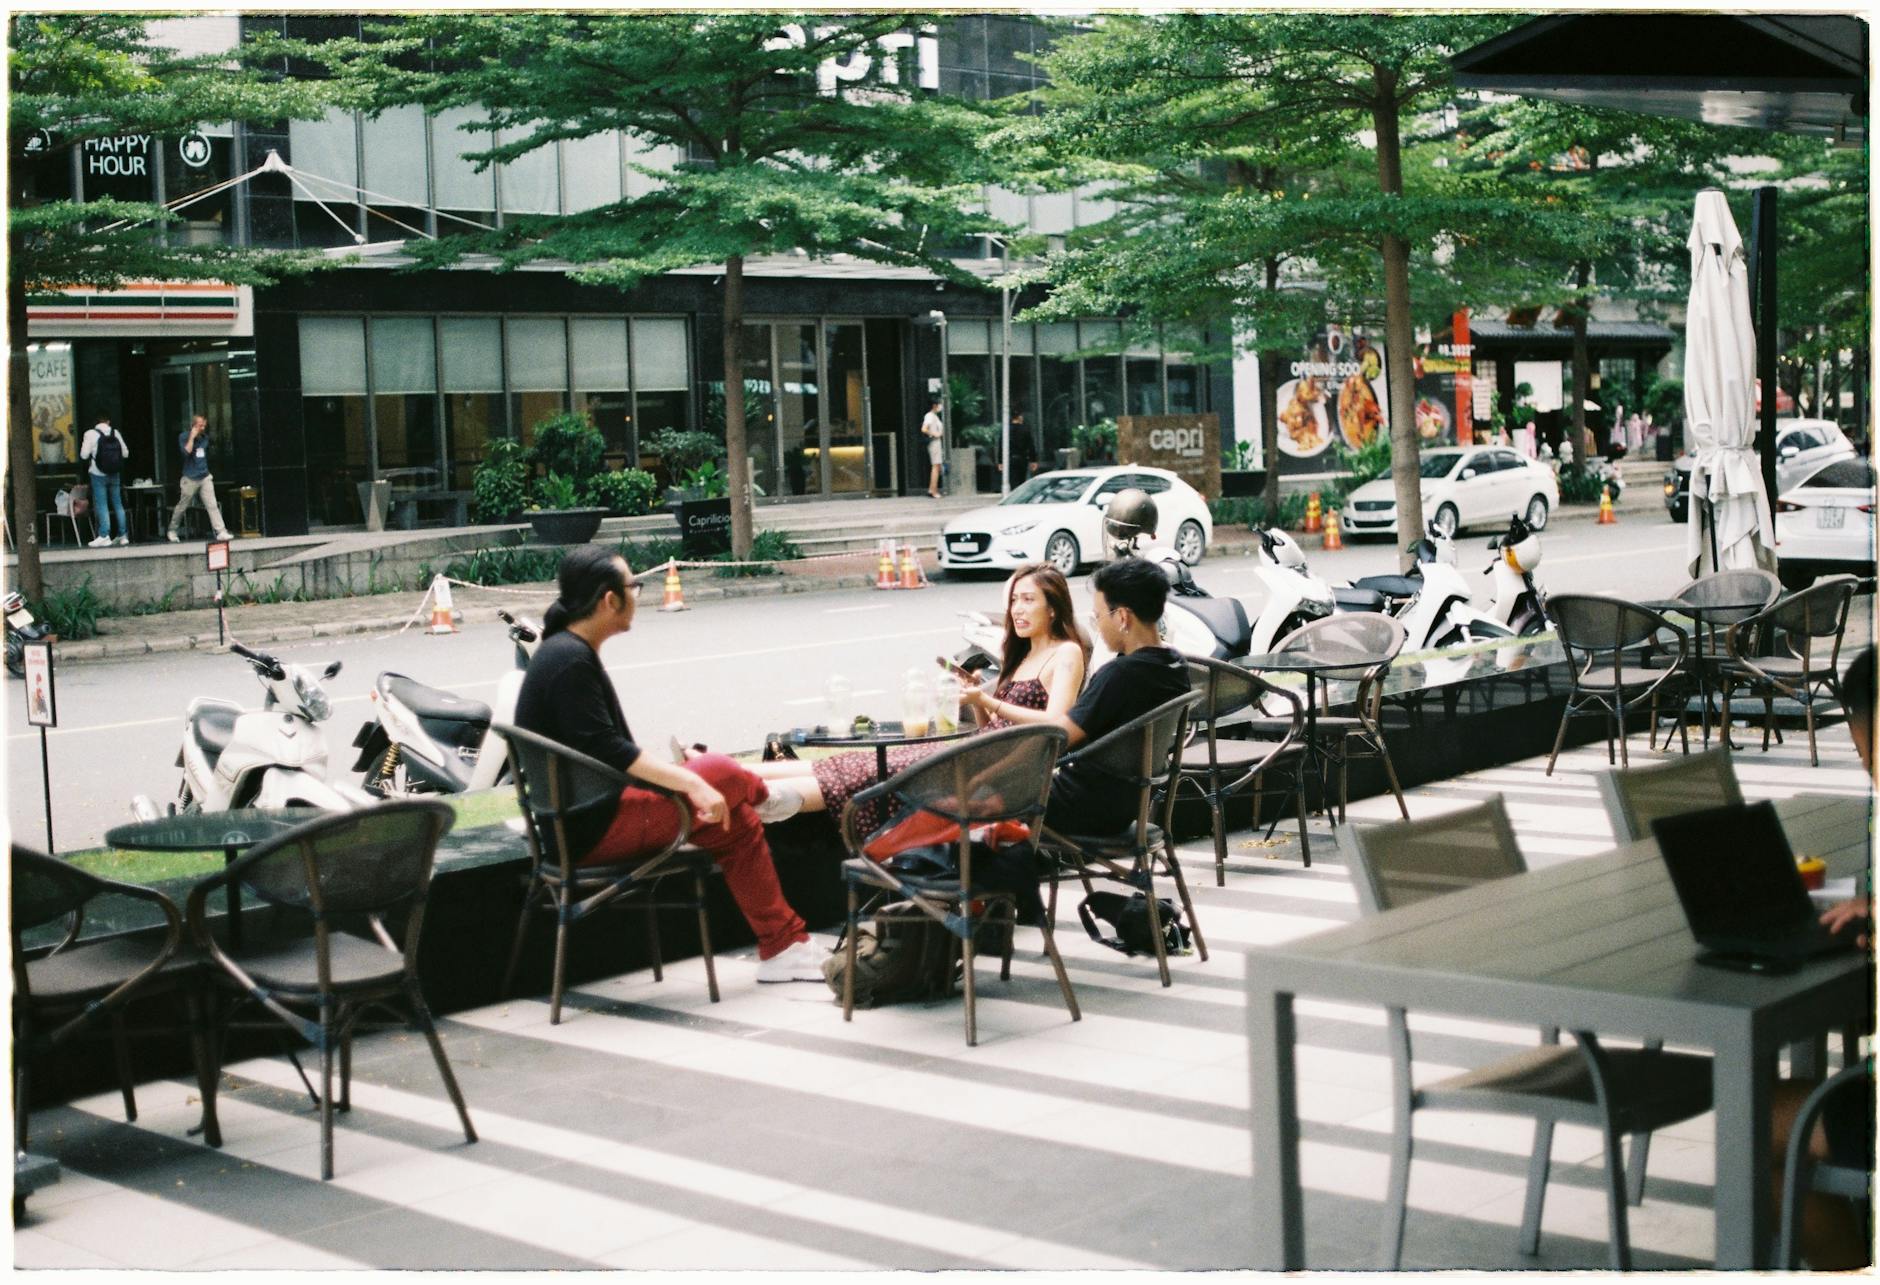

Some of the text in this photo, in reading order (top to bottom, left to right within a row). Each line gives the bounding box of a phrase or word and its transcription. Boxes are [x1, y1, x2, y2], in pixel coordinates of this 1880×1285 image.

[84, 134, 151, 154] HAPPY
[89, 155, 146, 176] HOUR
[1290, 361, 1362, 377] OPENING SOO
[1149, 421, 1205, 455] capri
[688, 512, 732, 528] Caprilicio
